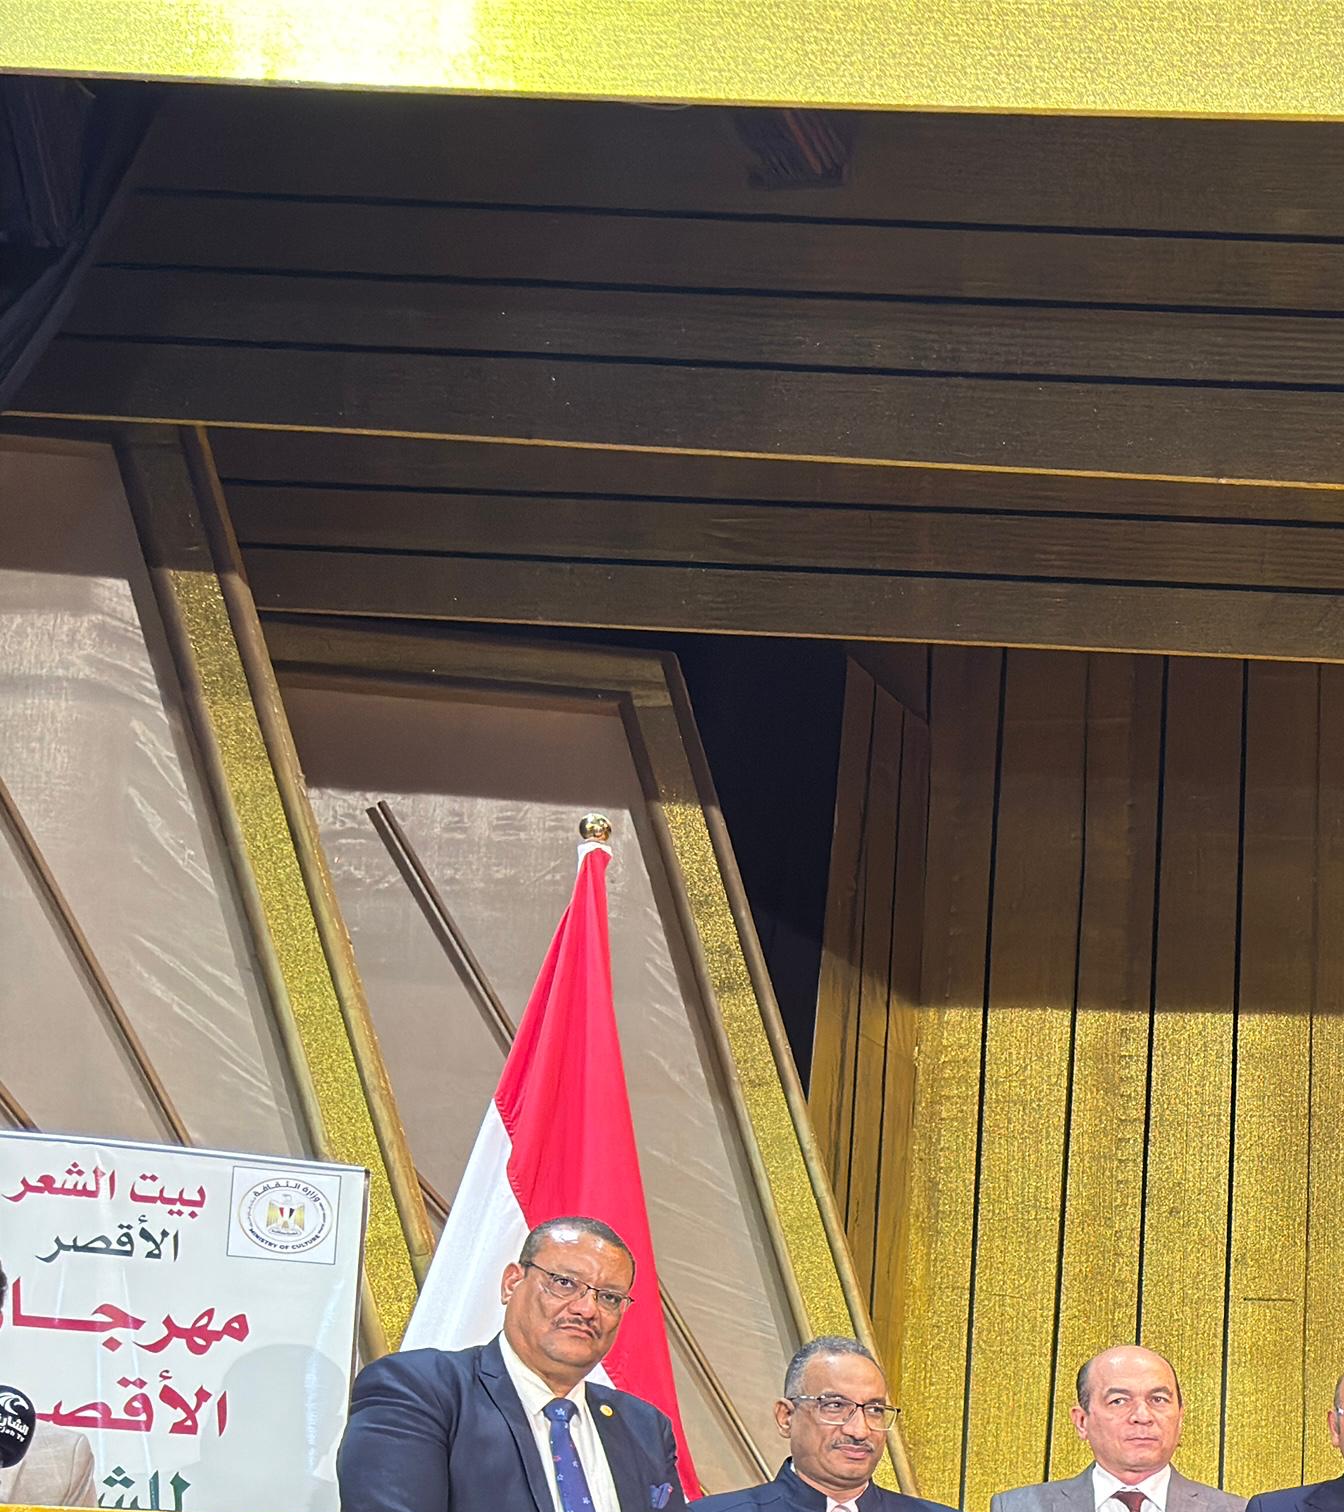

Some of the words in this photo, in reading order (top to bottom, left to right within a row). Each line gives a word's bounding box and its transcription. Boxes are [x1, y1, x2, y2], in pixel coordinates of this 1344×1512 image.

[1, 1161, 115, 1203] الشعر
[130, 1173, 207, 1219] بيت
[253, 1180, 301, 1198] الثقافة
[302, 1186, 321, 1203] وزارة
[35, 1214, 180, 1264] الأقصر
[248, 1228, 279, 1249] MINISTRY
[291, 1234, 321, 1250] CULTURE
[0, 1276, 250, 1356] مهرجا
[35, 1369, 229, 1437] الأقص
[98, 1465, 192, 1512] للش
